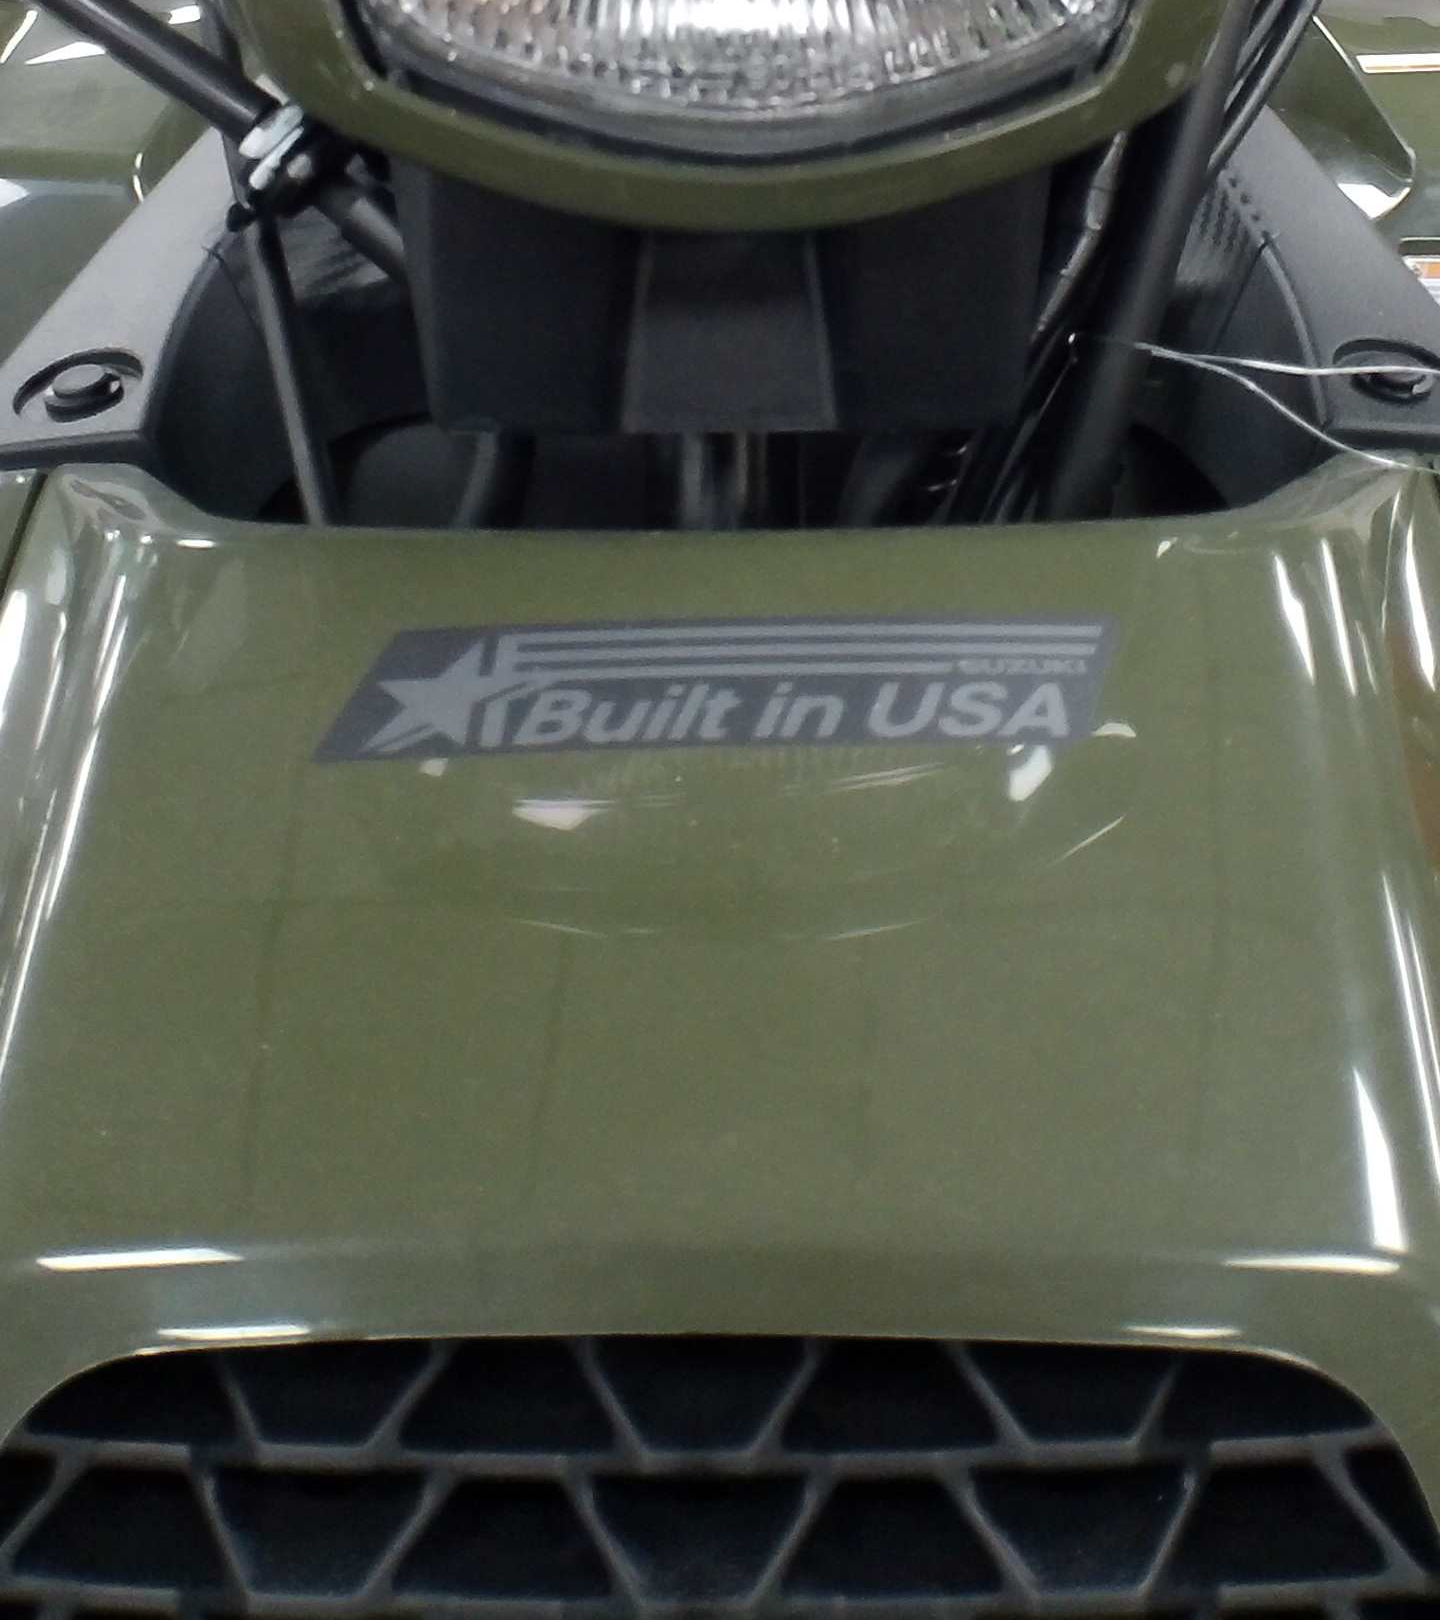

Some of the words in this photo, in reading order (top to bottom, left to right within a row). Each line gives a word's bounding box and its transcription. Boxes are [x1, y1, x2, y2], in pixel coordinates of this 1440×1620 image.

[512, 682, 741, 746] Built
[754, 680, 845, 739] in
[868, 680, 1071, 738] USA
